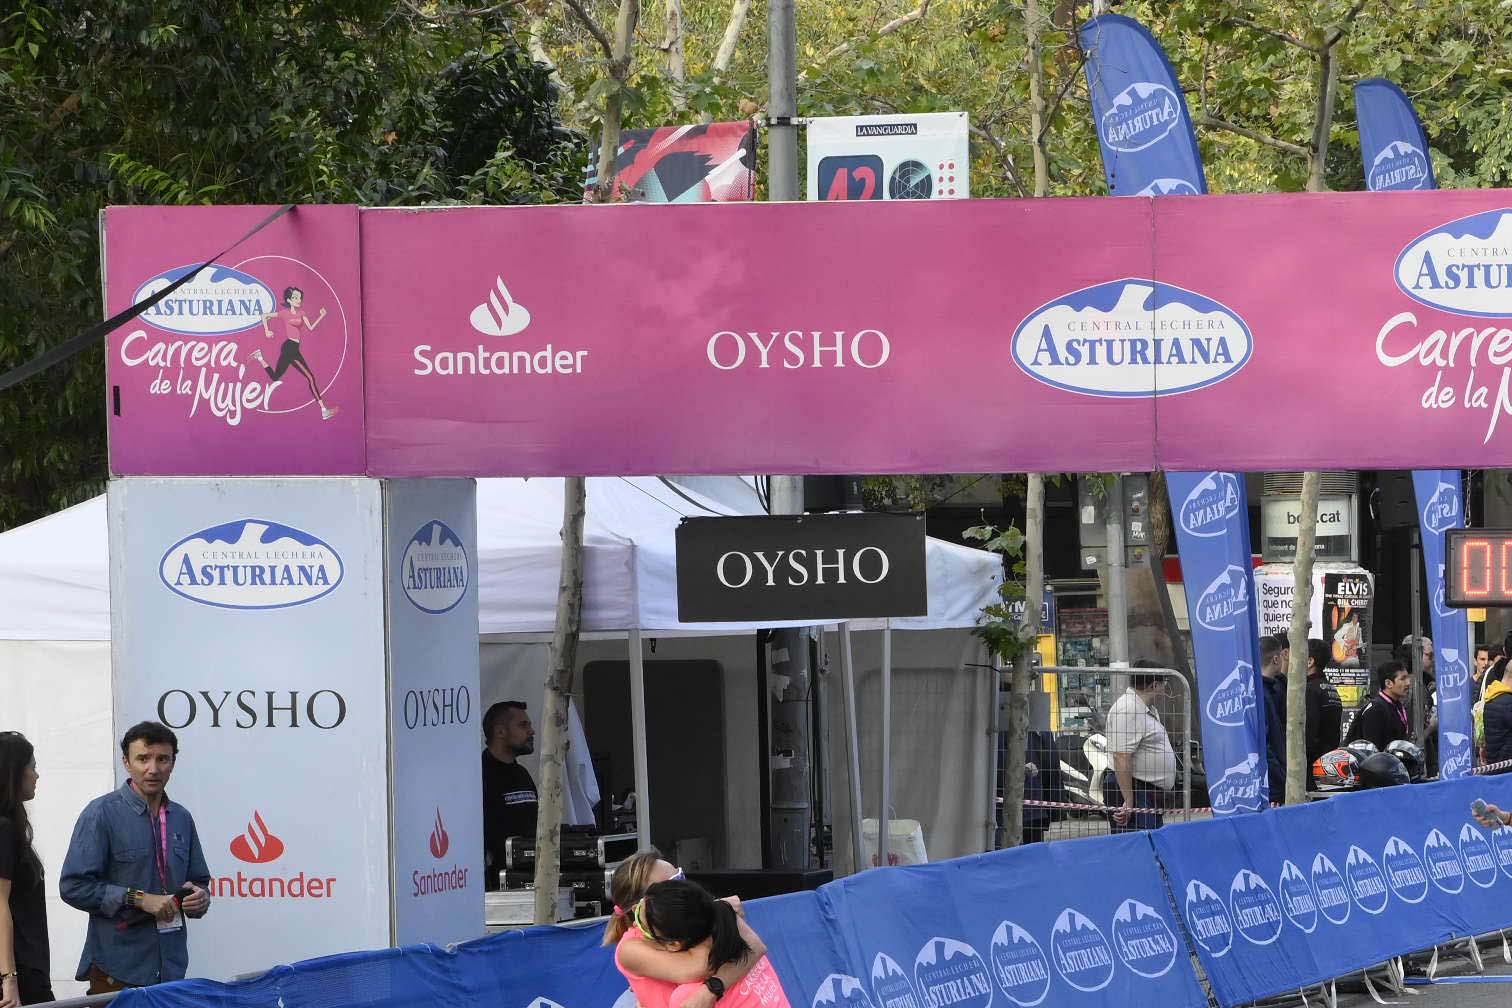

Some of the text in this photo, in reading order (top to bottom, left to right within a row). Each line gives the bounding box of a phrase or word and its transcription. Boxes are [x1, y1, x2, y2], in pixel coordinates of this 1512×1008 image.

[144, 289, 264, 317] ASTURIANA
[1067, 319, 1226, 332] CENTRAL LECHERA
[121, 330, 238, 367] Carrera
[414, 344, 588, 377] Santander
[706, 329, 891, 370] OYSHO
[1030, 323, 1234, 366] ASTURIANA
[150, 364, 283, 426] de la Mujer
[1421, 371, 1456, 409] de
[1464, 368, 1489, 409] la
[174, 553, 331, 587] ASTURIANA
[202, 551, 324, 560] CENTRAL LECHERA
[406, 554, 464, 591] ASTURIANA
[717, 546, 889, 588] OYSHO
[1263, 601, 1279, 610] que
[1338, 582, 1368, 595] ELVIS
[157, 689, 346, 729] OYSHO
[404, 685, 470, 729] OYSHO
[210, 871, 336, 898] ntander
[412, 864, 468, 898] Santander
[997, 960, 1045, 990] ASTURIANA
[1057, 944, 1111, 974] ASTURIANA
